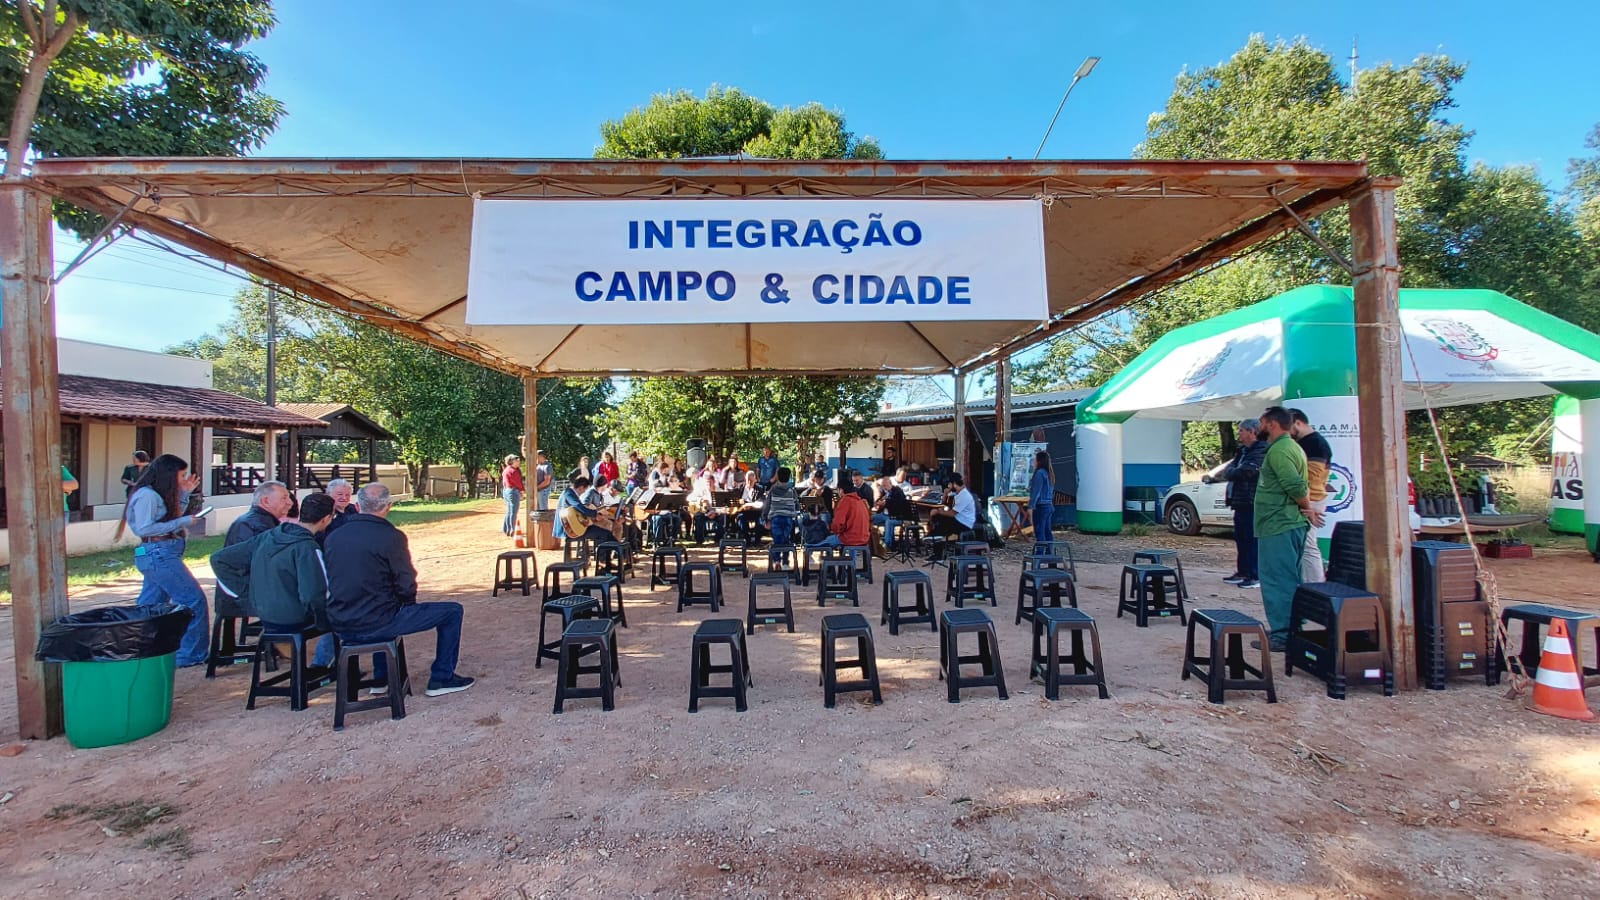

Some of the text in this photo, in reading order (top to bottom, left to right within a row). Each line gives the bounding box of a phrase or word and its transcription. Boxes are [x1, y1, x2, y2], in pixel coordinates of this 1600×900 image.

[628, 212, 922, 254] INTEGRAÇÃO
[574, 270, 972, 305] CAMPO & CIDADE
